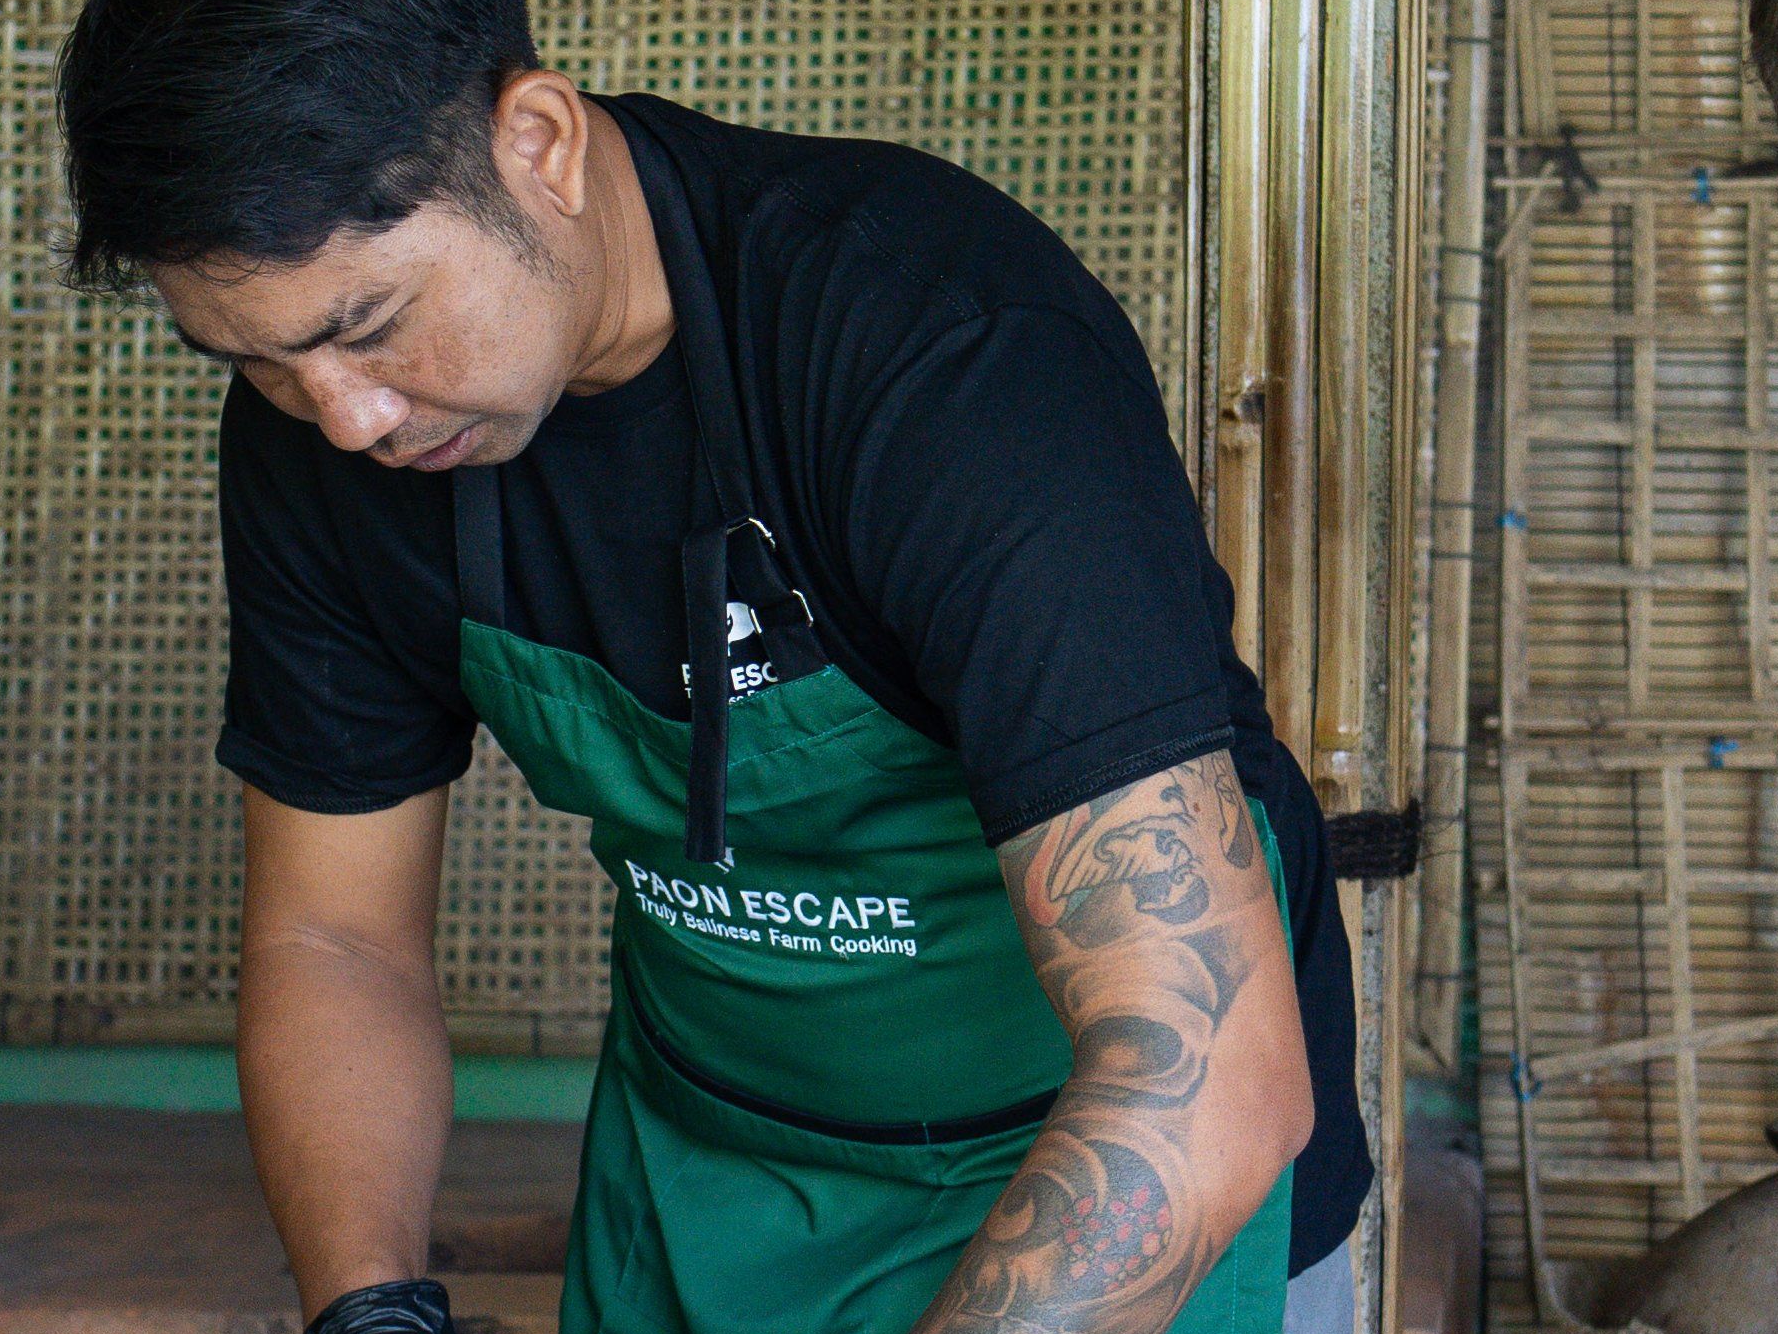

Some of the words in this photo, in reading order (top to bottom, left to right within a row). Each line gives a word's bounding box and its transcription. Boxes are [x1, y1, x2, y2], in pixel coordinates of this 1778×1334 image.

[625, 859, 732, 918] PAON
[739, 890, 916, 931] ESCAPE
[635, 893, 678, 928] Truly
[682, 910, 762, 944] Balinese
[769, 927, 822, 953] Farm
[830, 935, 917, 957] Cooking
